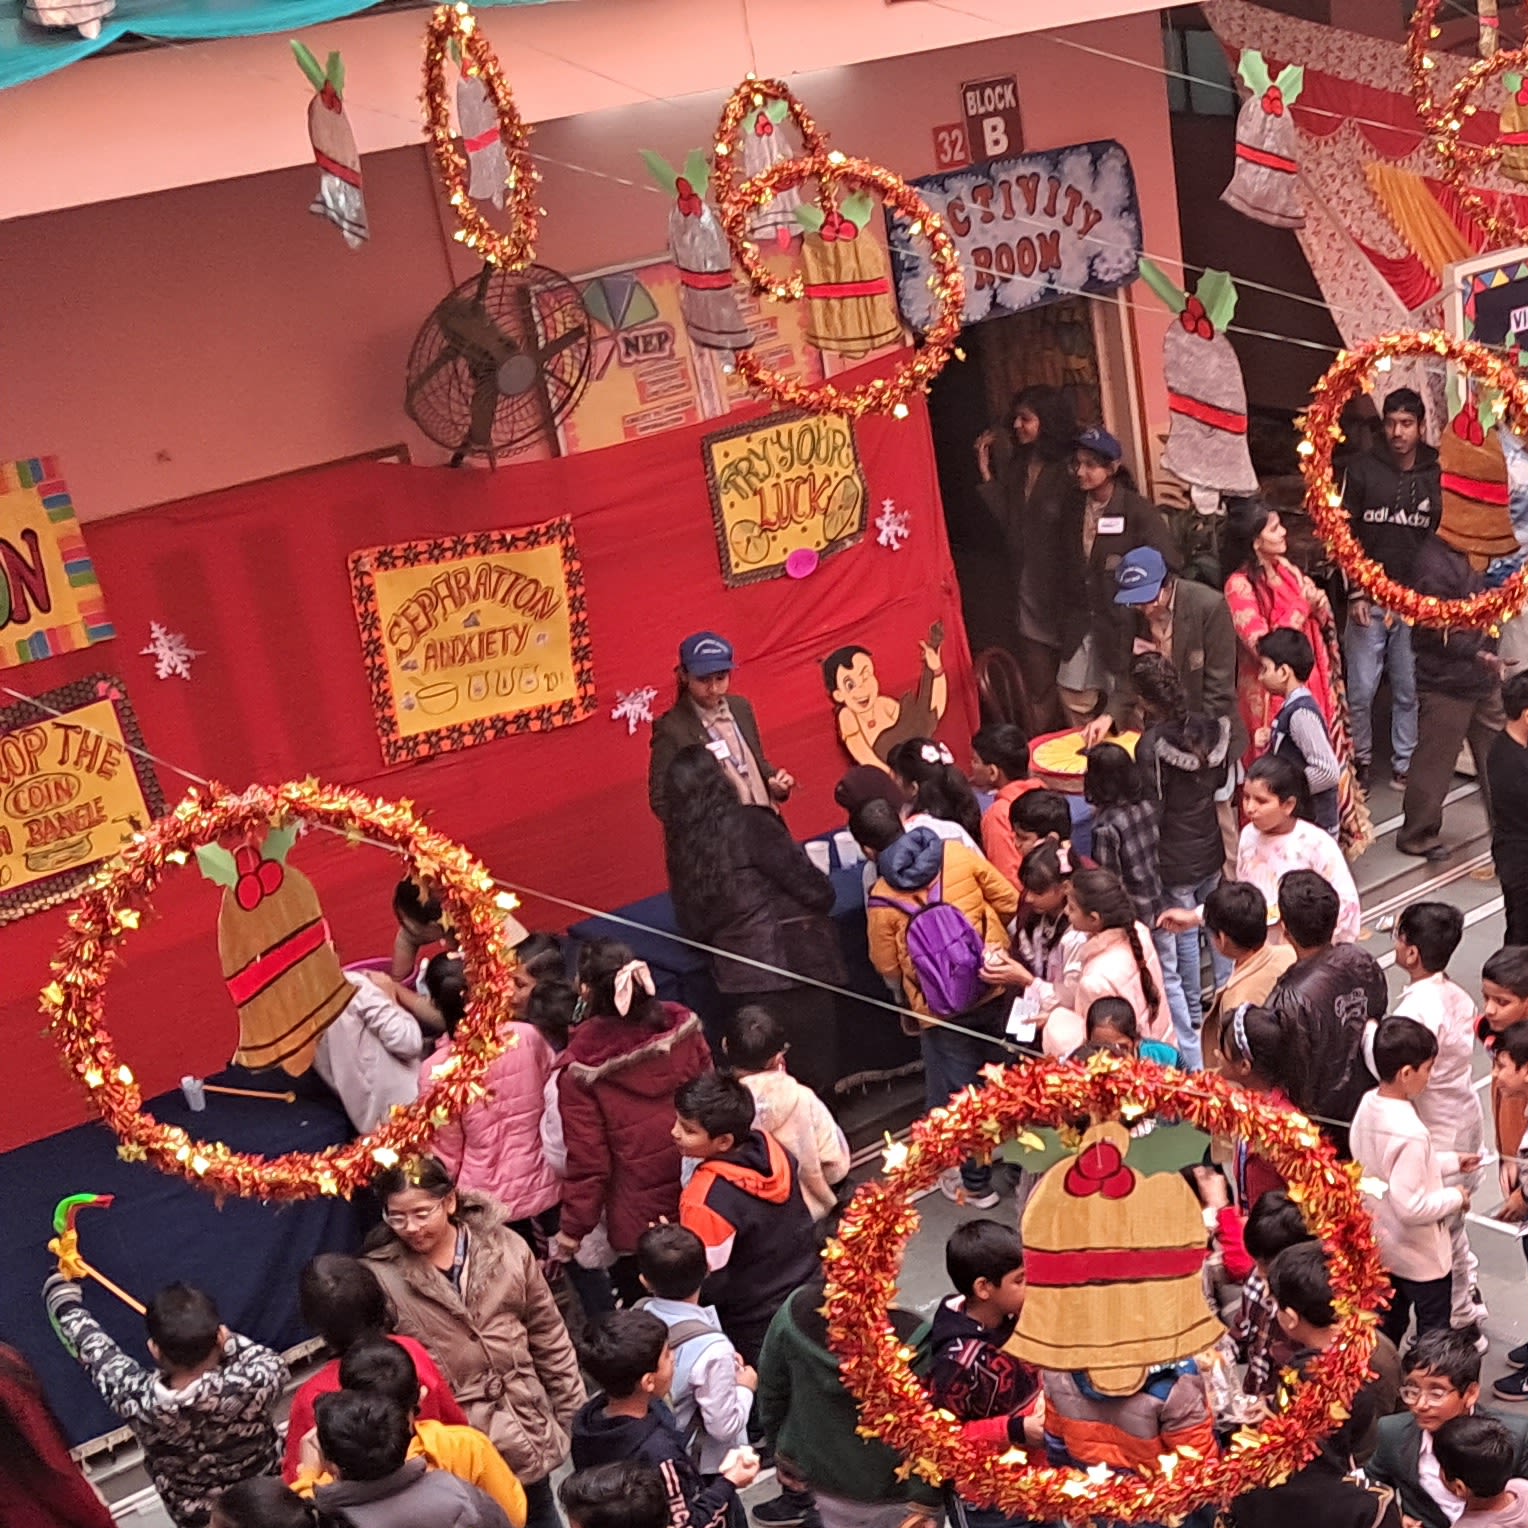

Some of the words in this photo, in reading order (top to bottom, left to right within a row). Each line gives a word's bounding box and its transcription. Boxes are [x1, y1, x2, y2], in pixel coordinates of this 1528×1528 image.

[966, 82, 1016, 117] BLOCK
[937, 128, 965, 163] 32
[983, 116, 1009, 157] B
[946, 171, 1102, 240] CTIVITY
[971, 229, 1062, 290] ROOM
[623, 330, 669, 357] NEP
[720, 436, 774, 500] TRY
[770, 418, 852, 473] YOUR
[753, 472, 832, 532] LUCK
[387, 562, 562, 664] SEPARATION
[422, 624, 532, 673] ANXIETY
[0, 726, 48, 787] OP
[51, 721, 124, 782] THE
[13, 776, 74, 816] COIN
[22, 795, 109, 849] BANGLE
